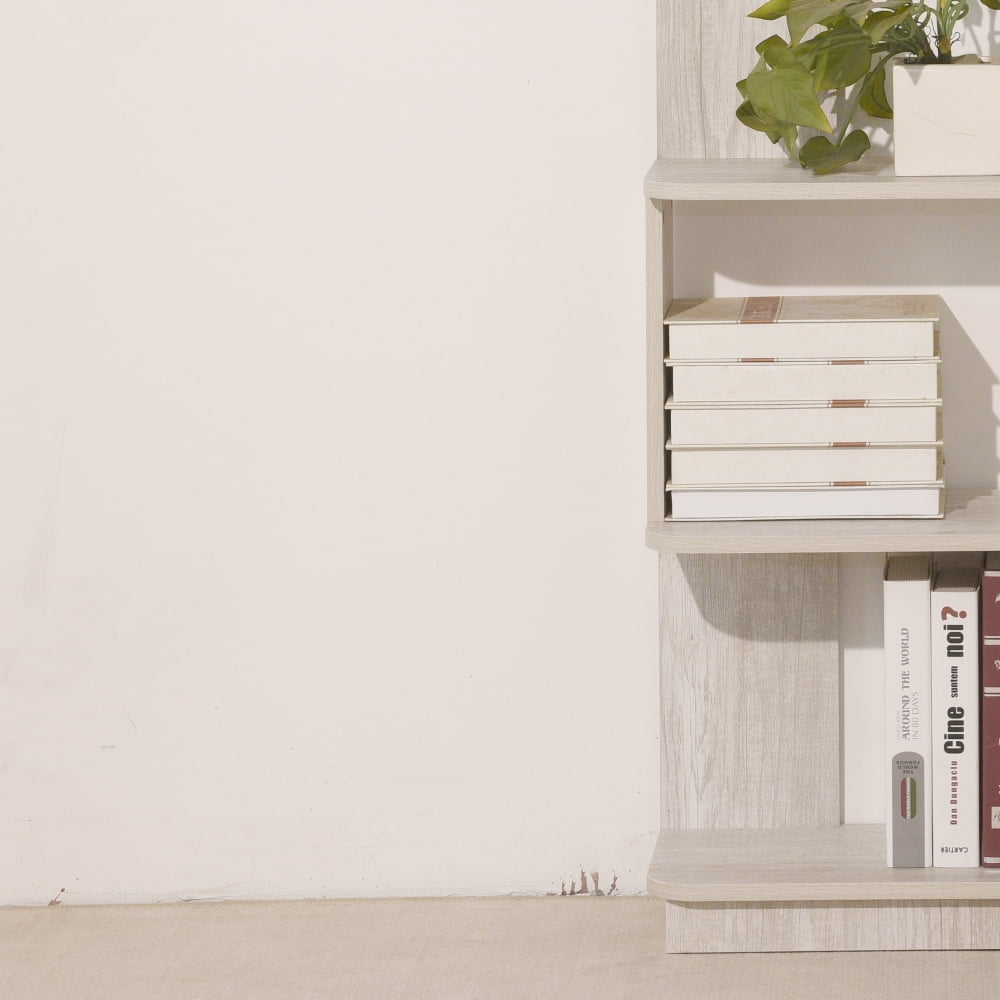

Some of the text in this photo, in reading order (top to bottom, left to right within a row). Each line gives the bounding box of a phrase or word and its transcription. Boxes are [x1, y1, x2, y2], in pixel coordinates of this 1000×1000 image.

[900, 627, 911, 741] AROUND THE WORLD
[949, 665, 958, 698] suntem
[911, 691, 920, 740] IN 80 DAYS
[943, 706, 965, 754] Cine
[949, 808, 958, 826] Dan
